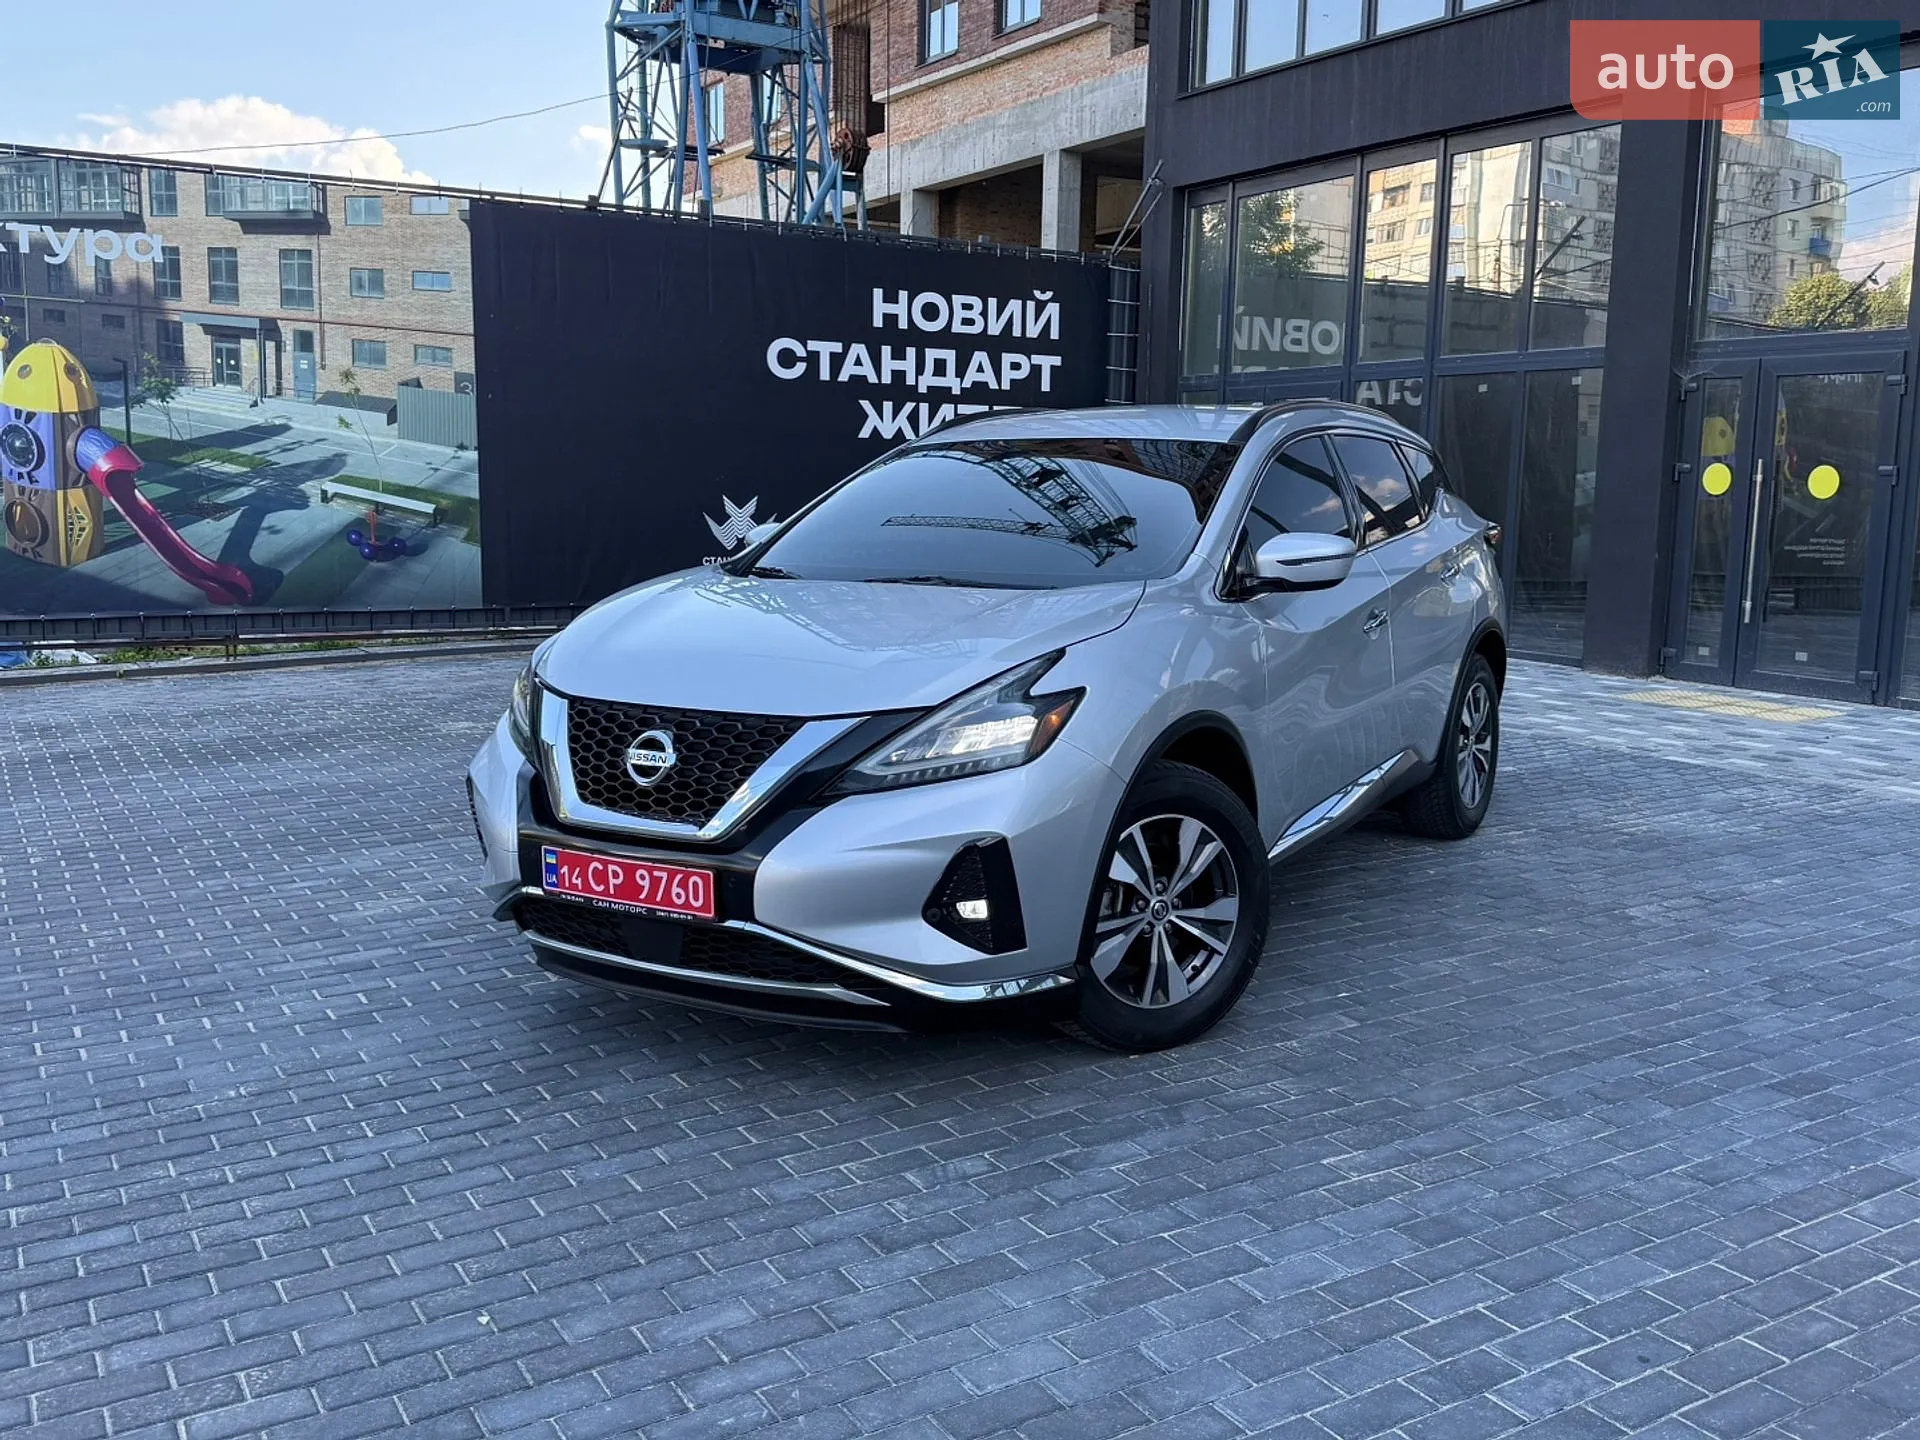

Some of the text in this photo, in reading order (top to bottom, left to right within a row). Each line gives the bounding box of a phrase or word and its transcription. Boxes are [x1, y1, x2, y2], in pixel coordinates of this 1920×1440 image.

[0, 222, 164, 266] тура
[872, 287, 1061, 340] НОВИЙ
[766, 337, 1062, 395] СТАНДАРТ
[546, 872, 558, 885] UA
[560, 865, 582, 891] 14
[634, 868, 704, 909] 9760
[611, 902, 648, 916] МОТОРС
